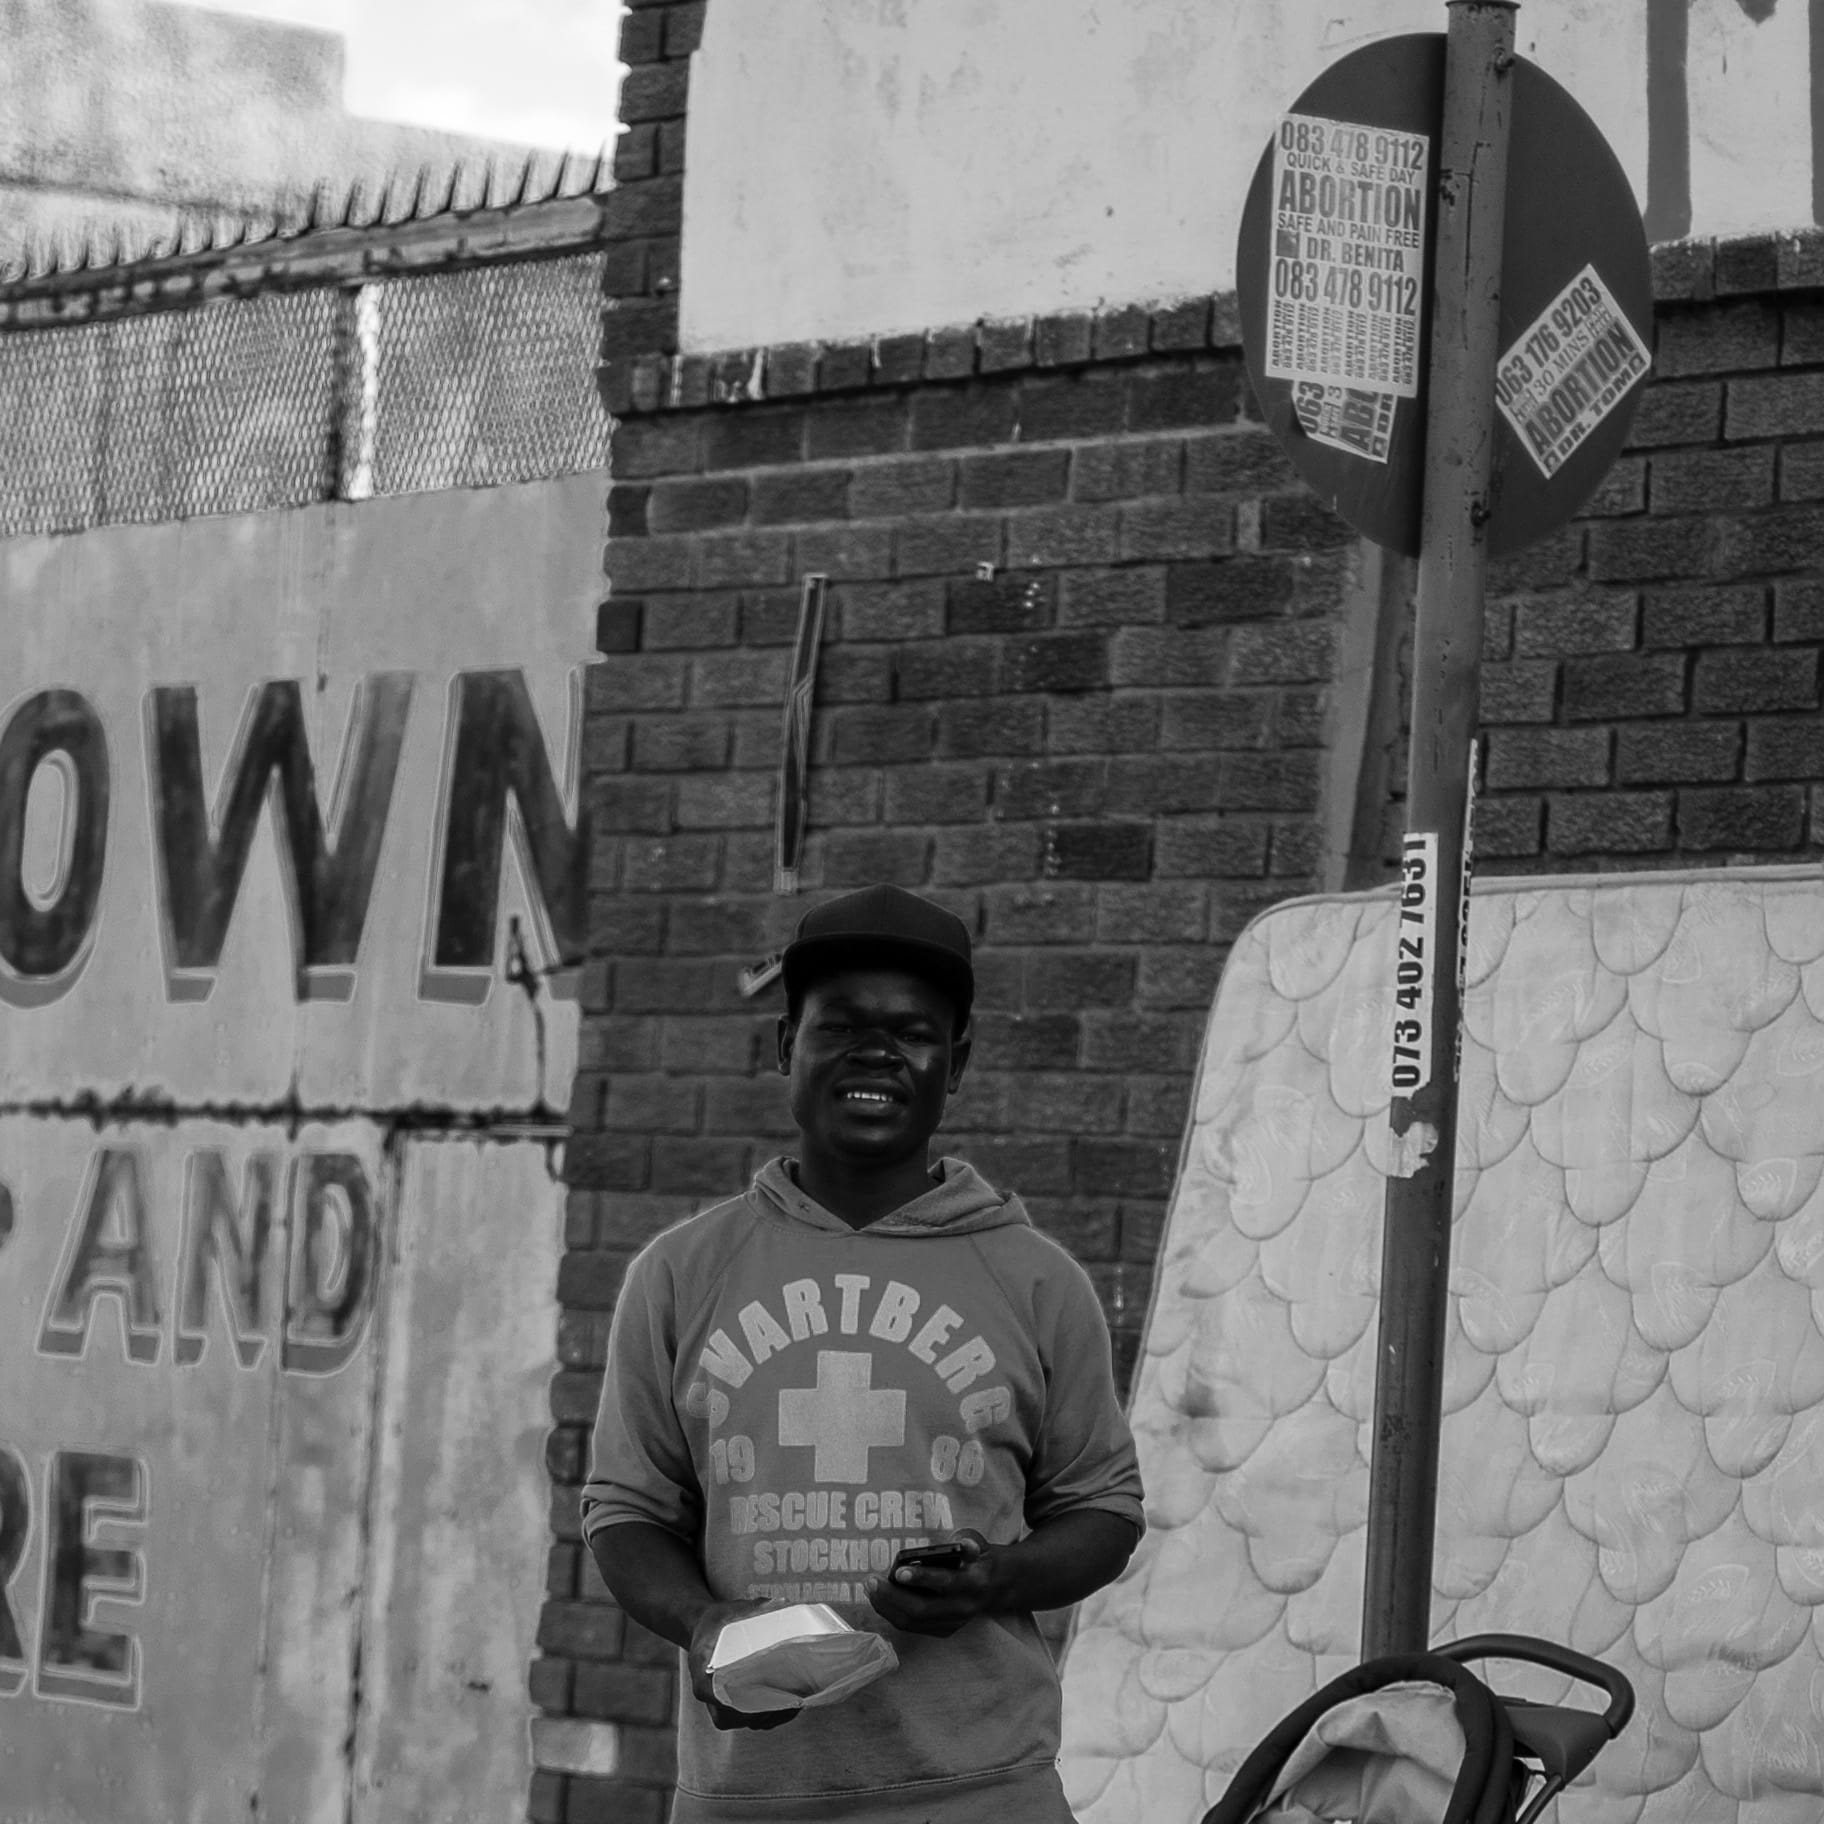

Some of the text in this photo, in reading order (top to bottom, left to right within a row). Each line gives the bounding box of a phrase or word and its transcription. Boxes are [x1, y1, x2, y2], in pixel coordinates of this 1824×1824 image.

[1281, 121, 1424, 170] 083 478 9112
[1287, 152, 1331, 172] QUICK
[1351, 162, 1385, 180] SAFE
[1389, 168, 1416, 185] DAY
[1278, 169, 1421, 231] ABORTION
[1278, 213, 1420, 249] SAFE AND PAIN FREE
[1307, 237, 1404, 272] DR. BENITA
[1276, 258, 1417, 316] 083 478 9112
[1496, 355, 1533, 406] 063
[1525, 323, 1560, 369] 176
[1552, 276, 1602, 338] 9203
[1533, 329, 1590, 397] 30 MINS
[1526, 319, 1635, 458] ABORTION
[1589, 368, 1633, 417] TOM
[1395, 936, 1425, 1011] 402
[1392, 1018, 1423, 1089] 073
[38, 1146, 378, 1376] AND
[709, 1435, 756, 1485] 19
[729, 1491, 848, 1535] RESCUE
